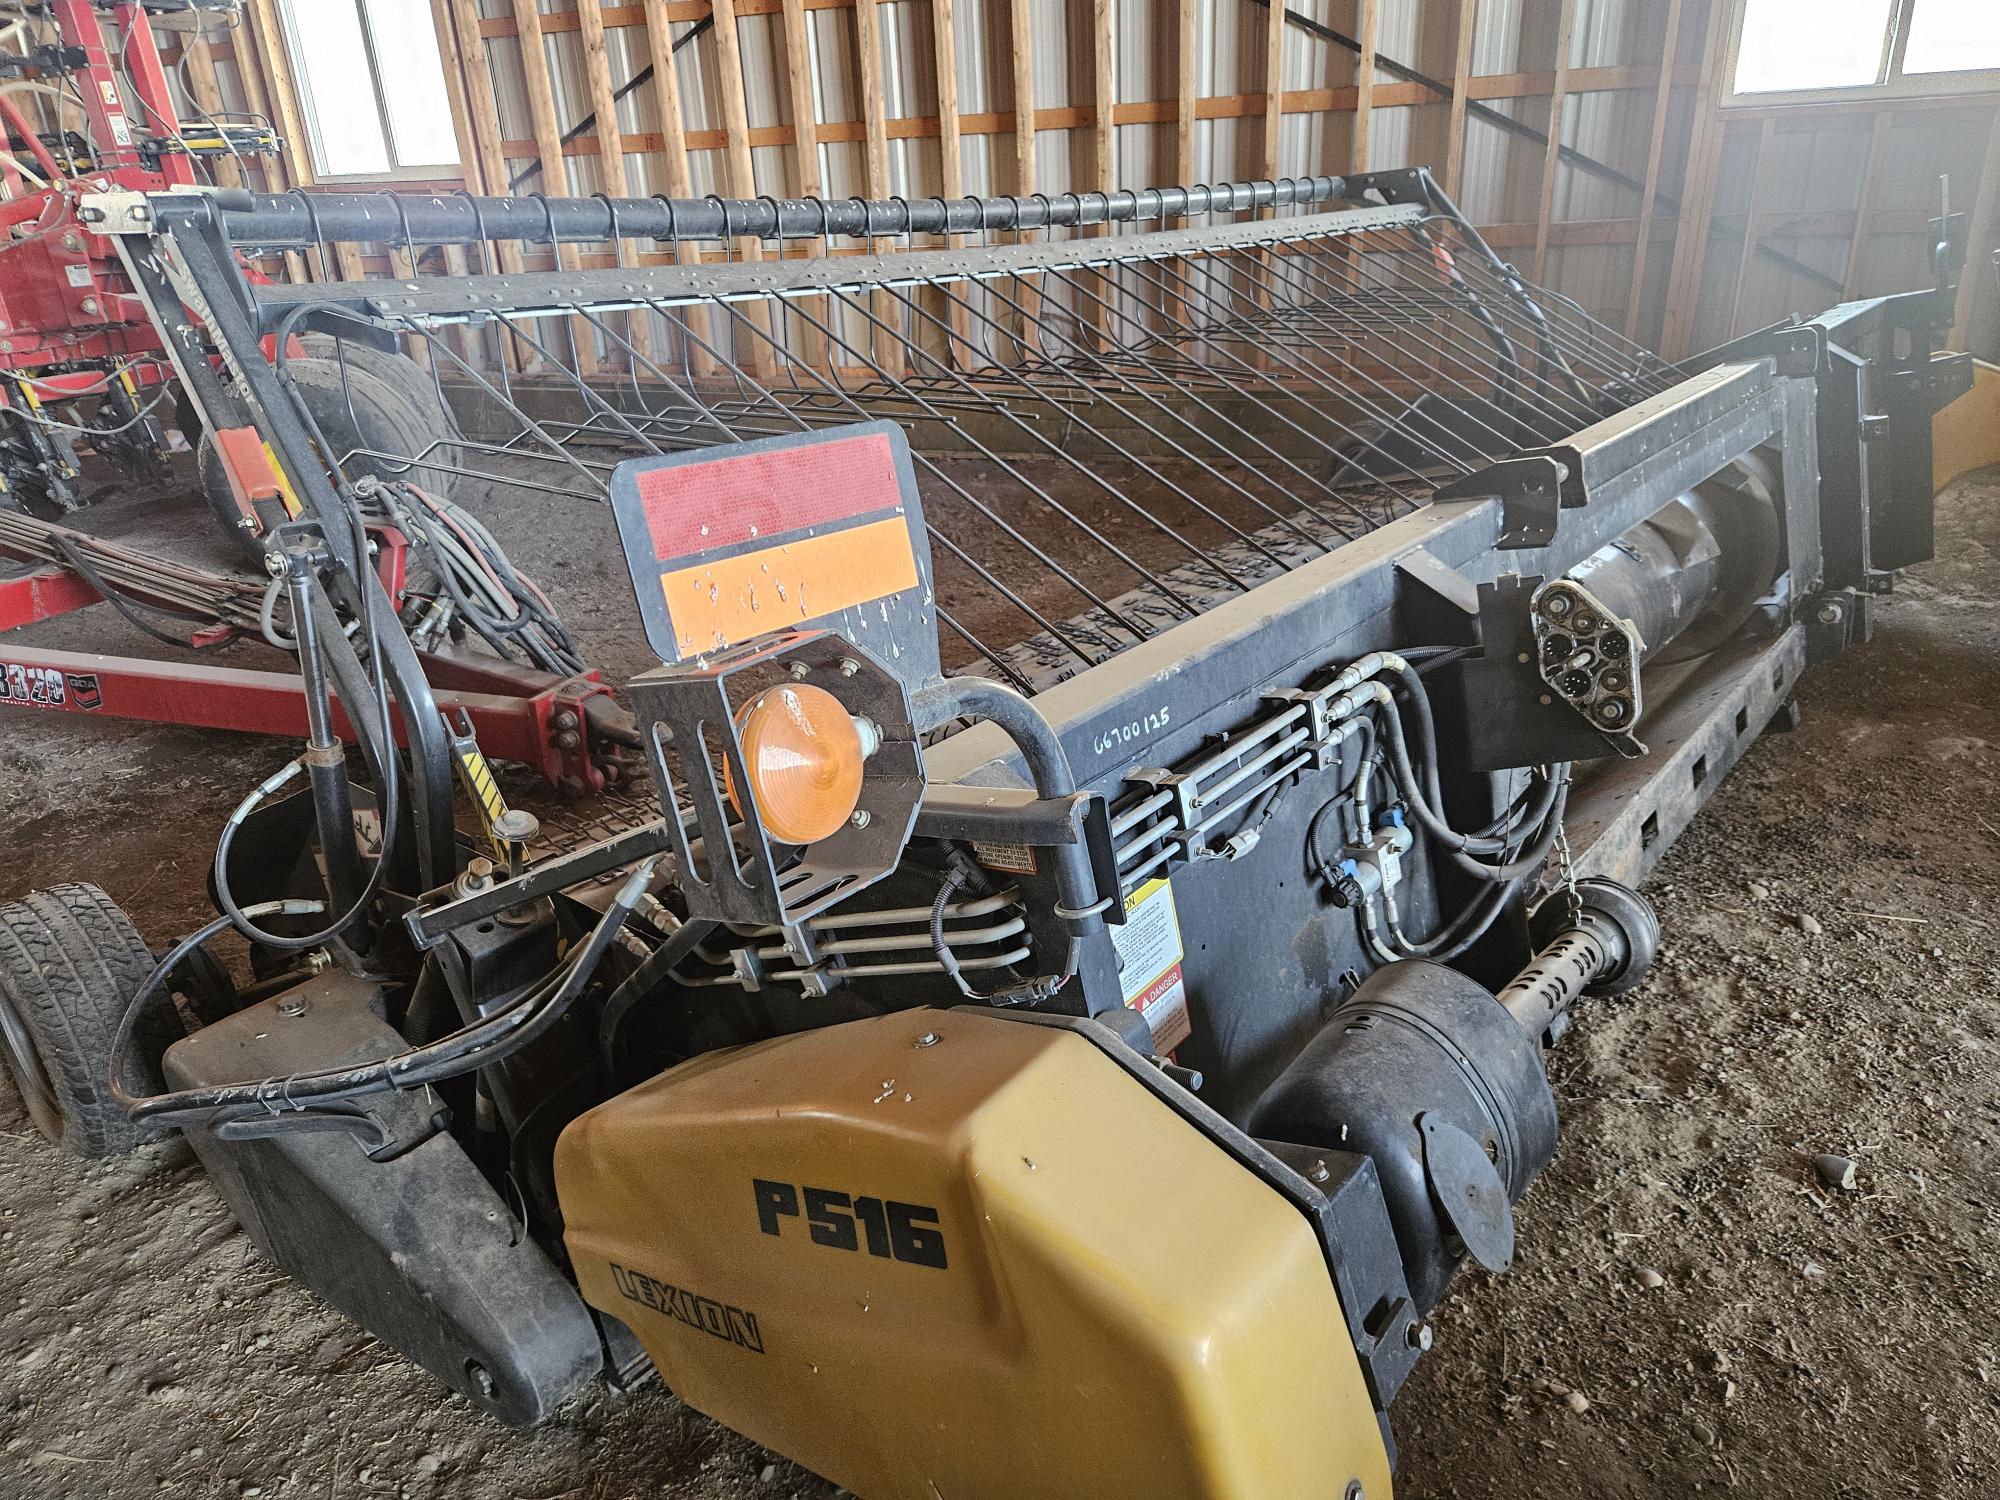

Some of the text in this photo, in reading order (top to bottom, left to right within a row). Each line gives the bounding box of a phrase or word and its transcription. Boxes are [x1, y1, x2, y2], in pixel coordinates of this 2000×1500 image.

[181, 264, 256, 406] SwathMaster
[1149, 971, 1179, 1001] DANGER
[609, 1262, 766, 1355] LEXION
